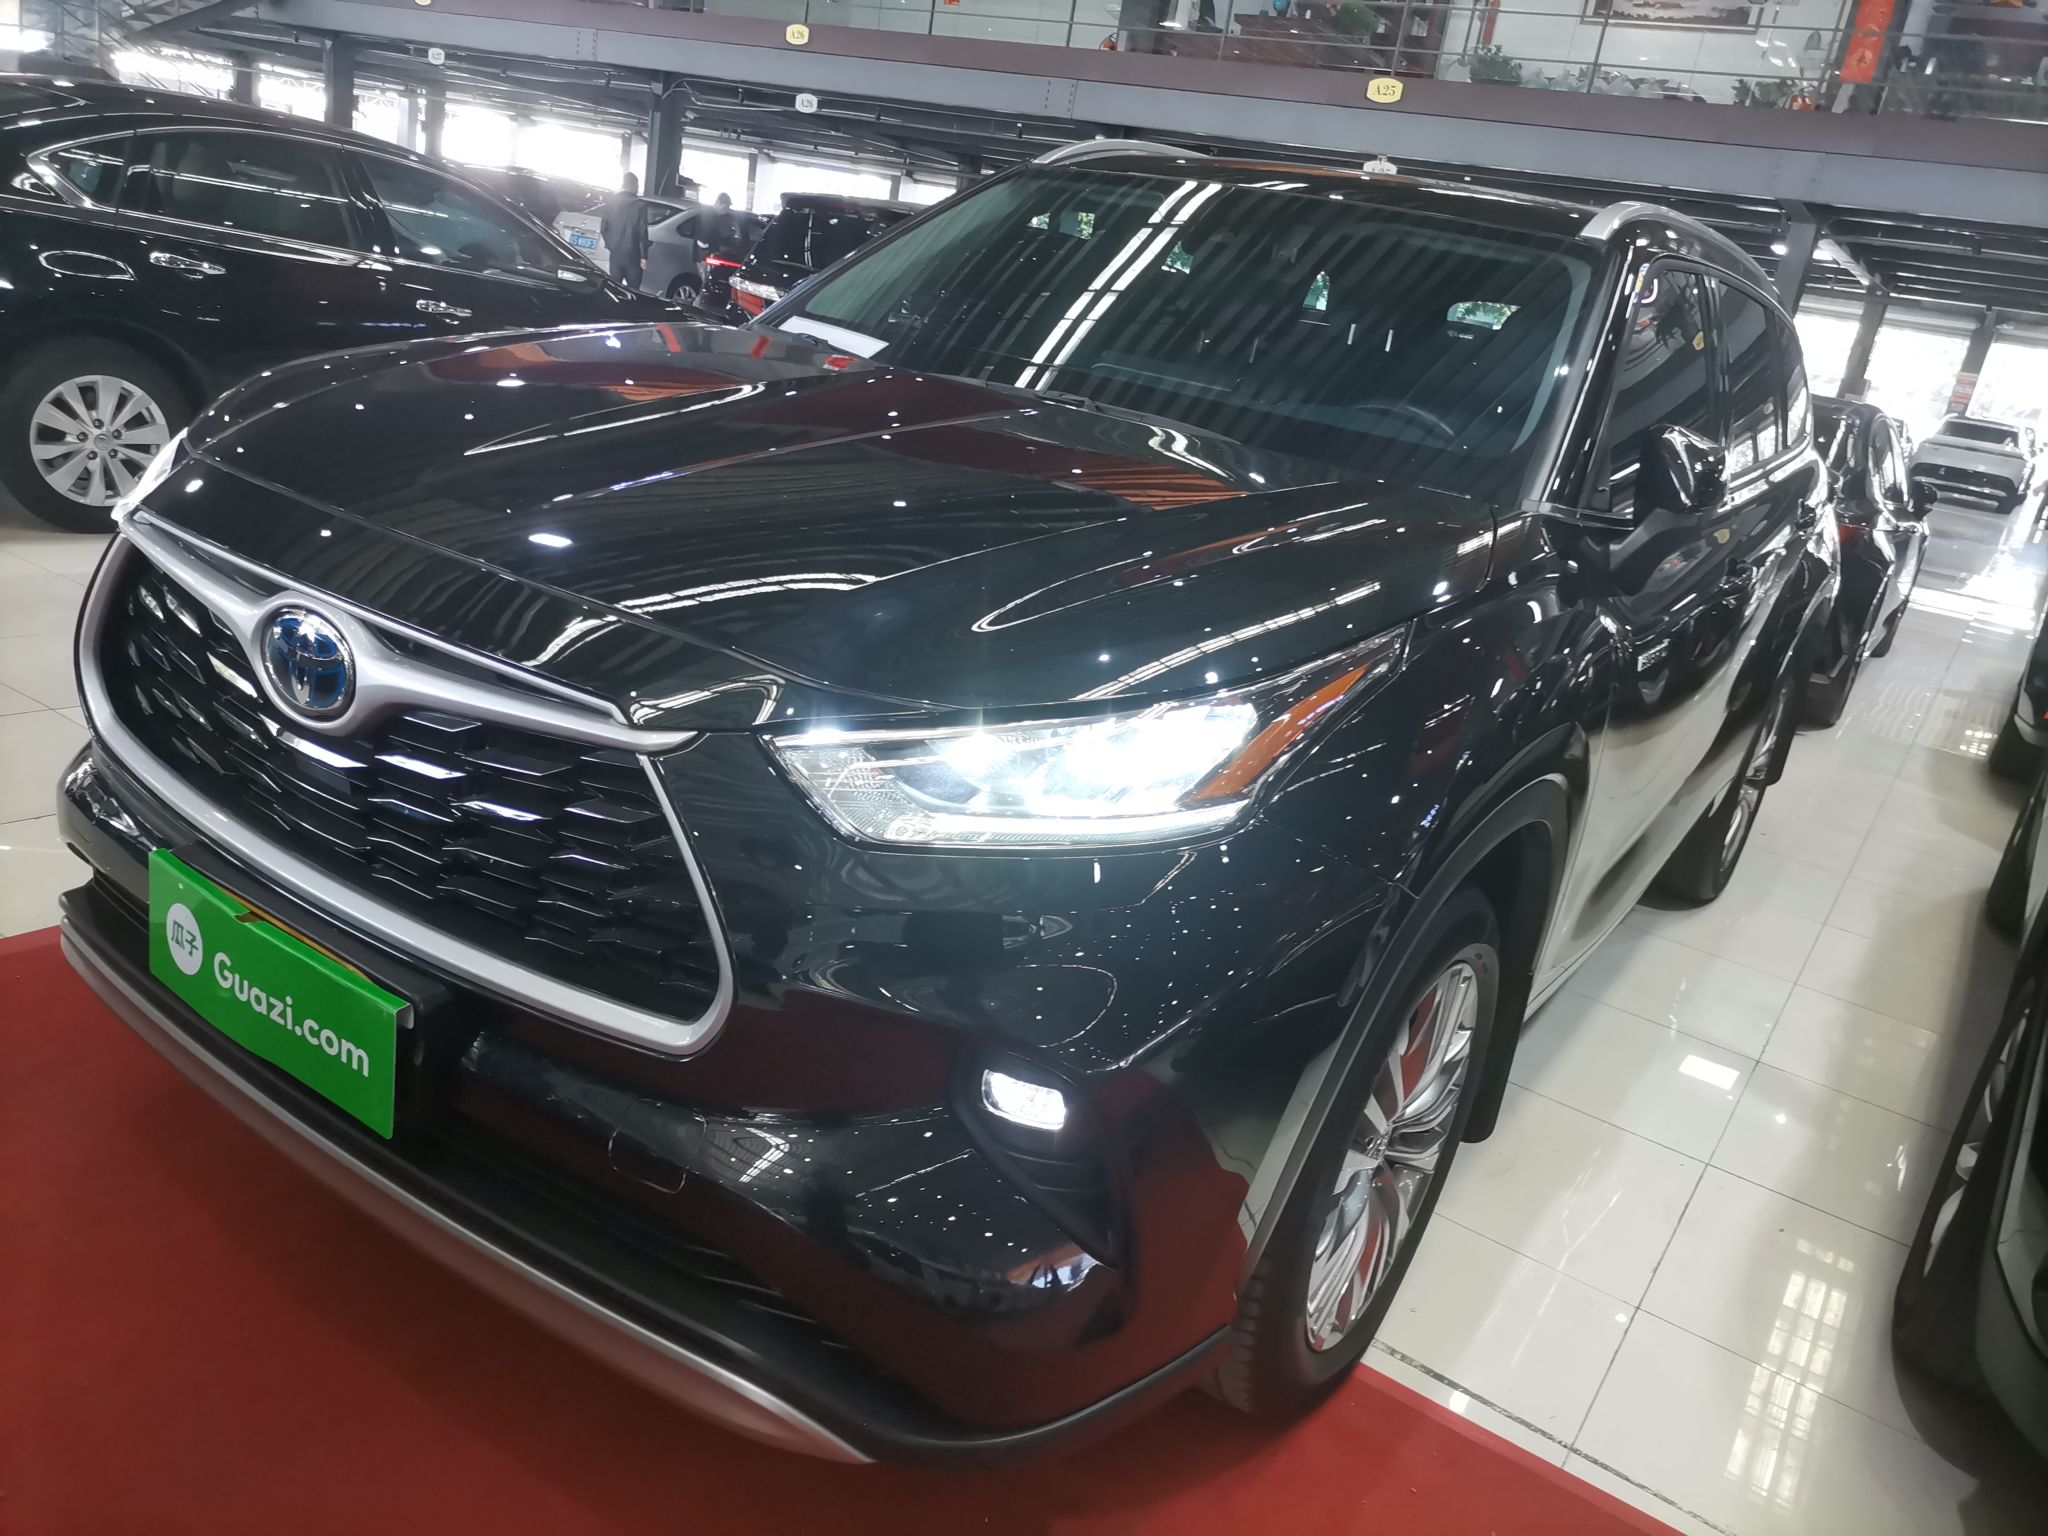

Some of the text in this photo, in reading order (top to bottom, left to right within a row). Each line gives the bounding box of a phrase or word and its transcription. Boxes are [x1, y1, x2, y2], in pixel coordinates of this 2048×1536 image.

[1372, 84, 1397, 96] A25
[171, 919, 199, 957] 瓜子
[213, 952, 369, 1078] Guazi.com
